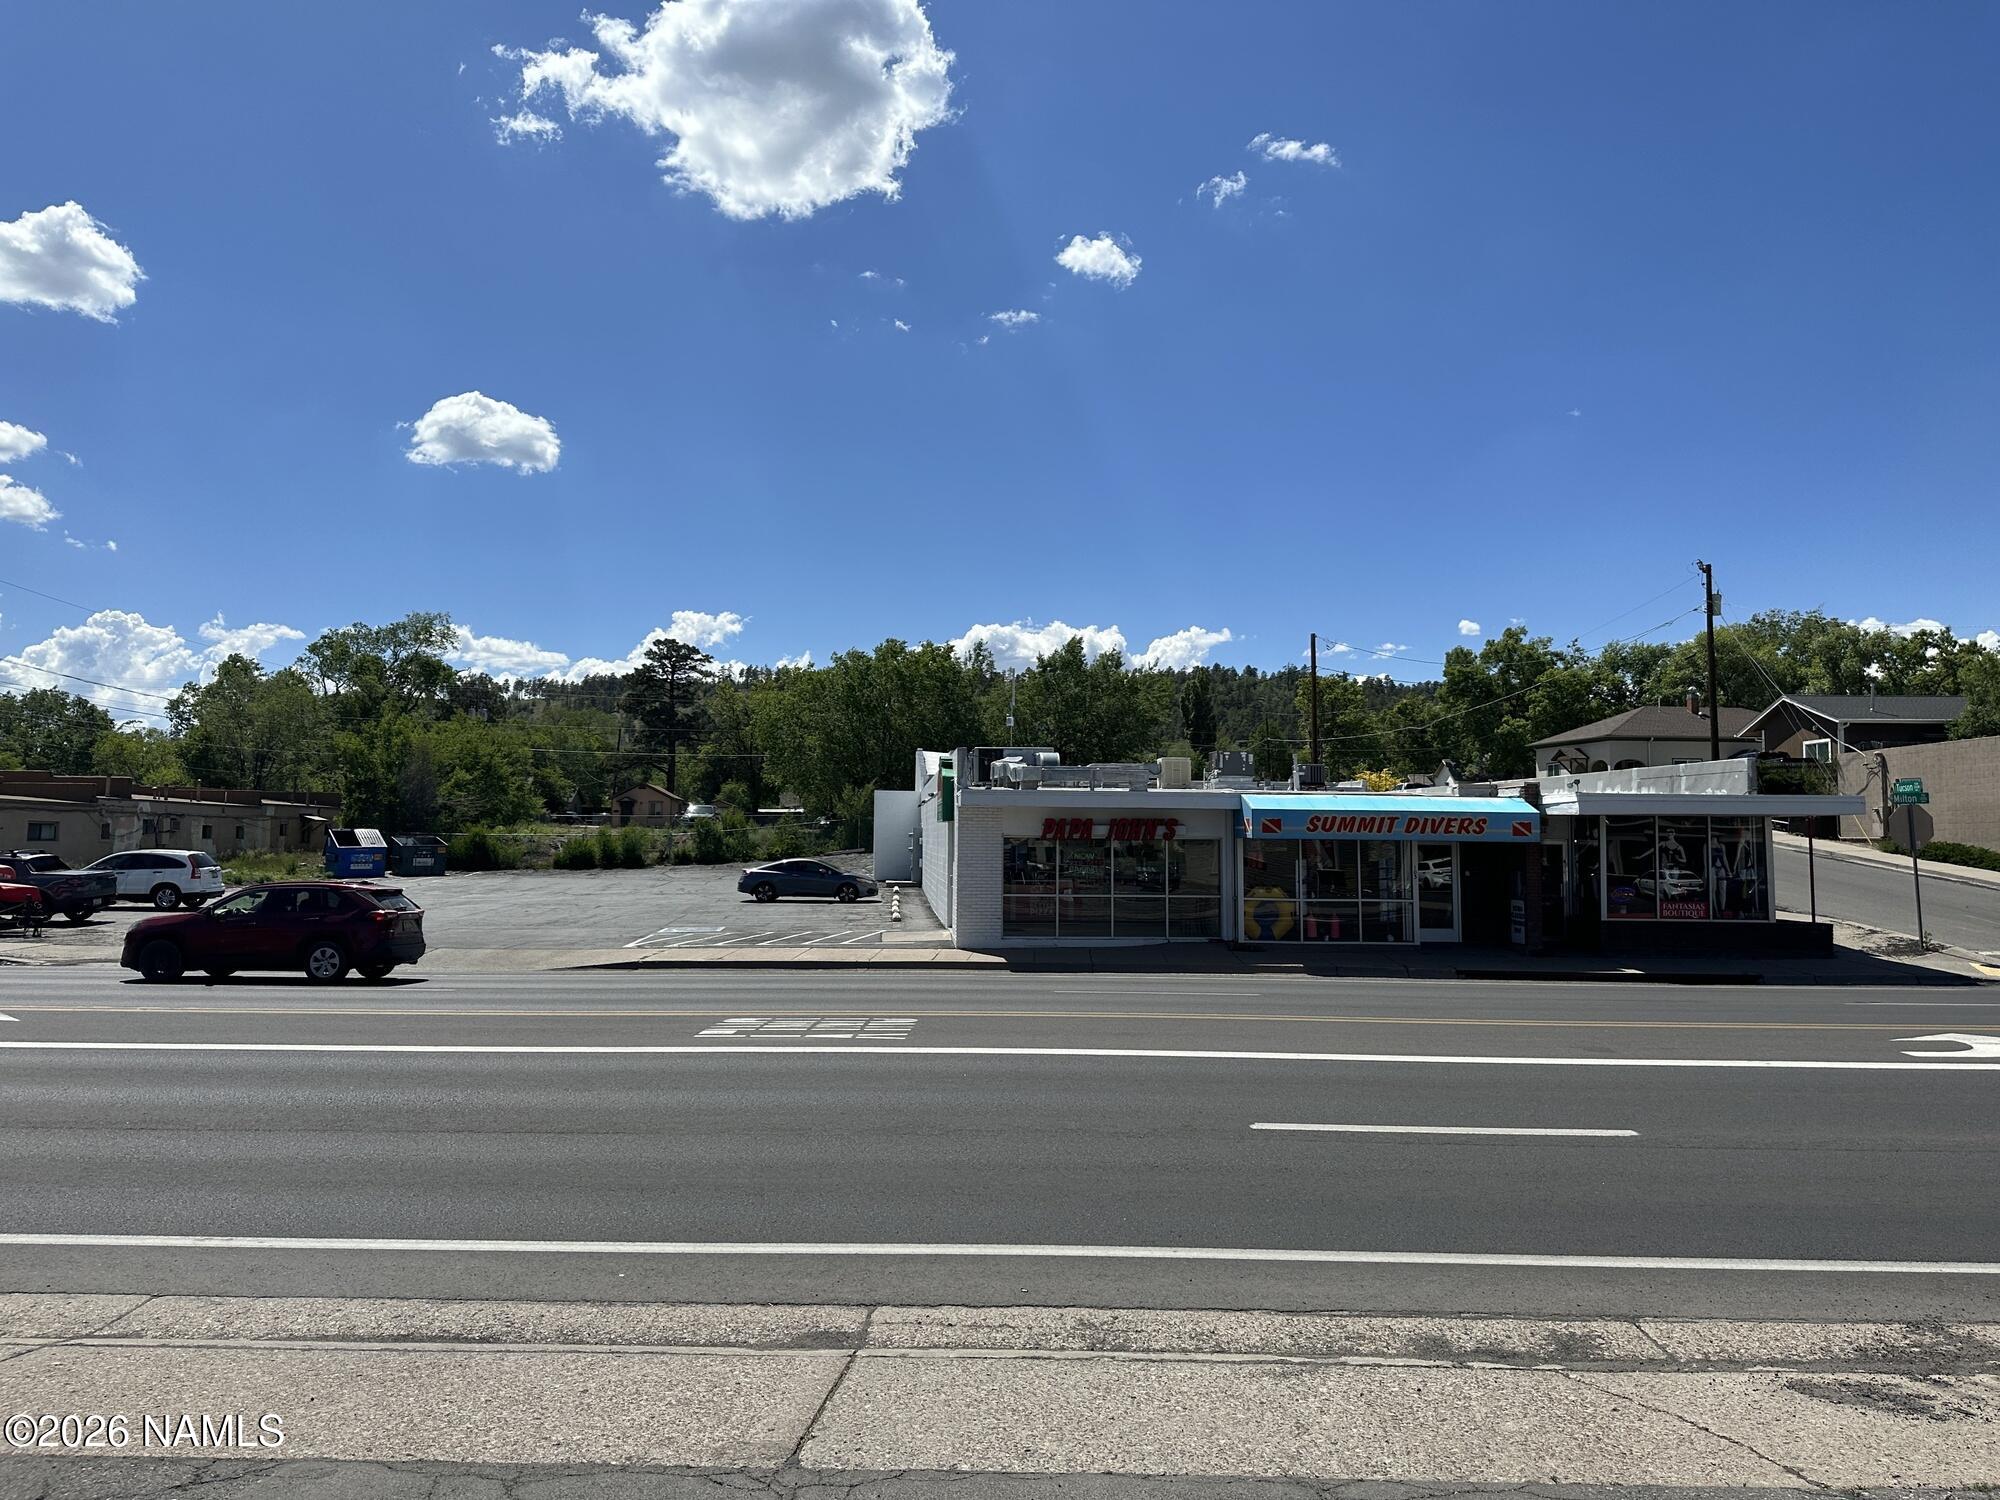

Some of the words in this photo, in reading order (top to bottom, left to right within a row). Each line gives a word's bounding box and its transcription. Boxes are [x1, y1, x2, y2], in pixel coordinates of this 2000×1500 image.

[1896, 783, 1913, 792] Tucson
[1893, 794, 1917, 803] Milton
[1040, 818, 1093, 840] PAPA
[1107, 818, 1178, 841] JOHN'S
[1305, 815, 1400, 834] SUMMIT
[1404, 816, 1488, 835] DIVERS
[1662, 909, 1704, 918] BOUTIQUE
